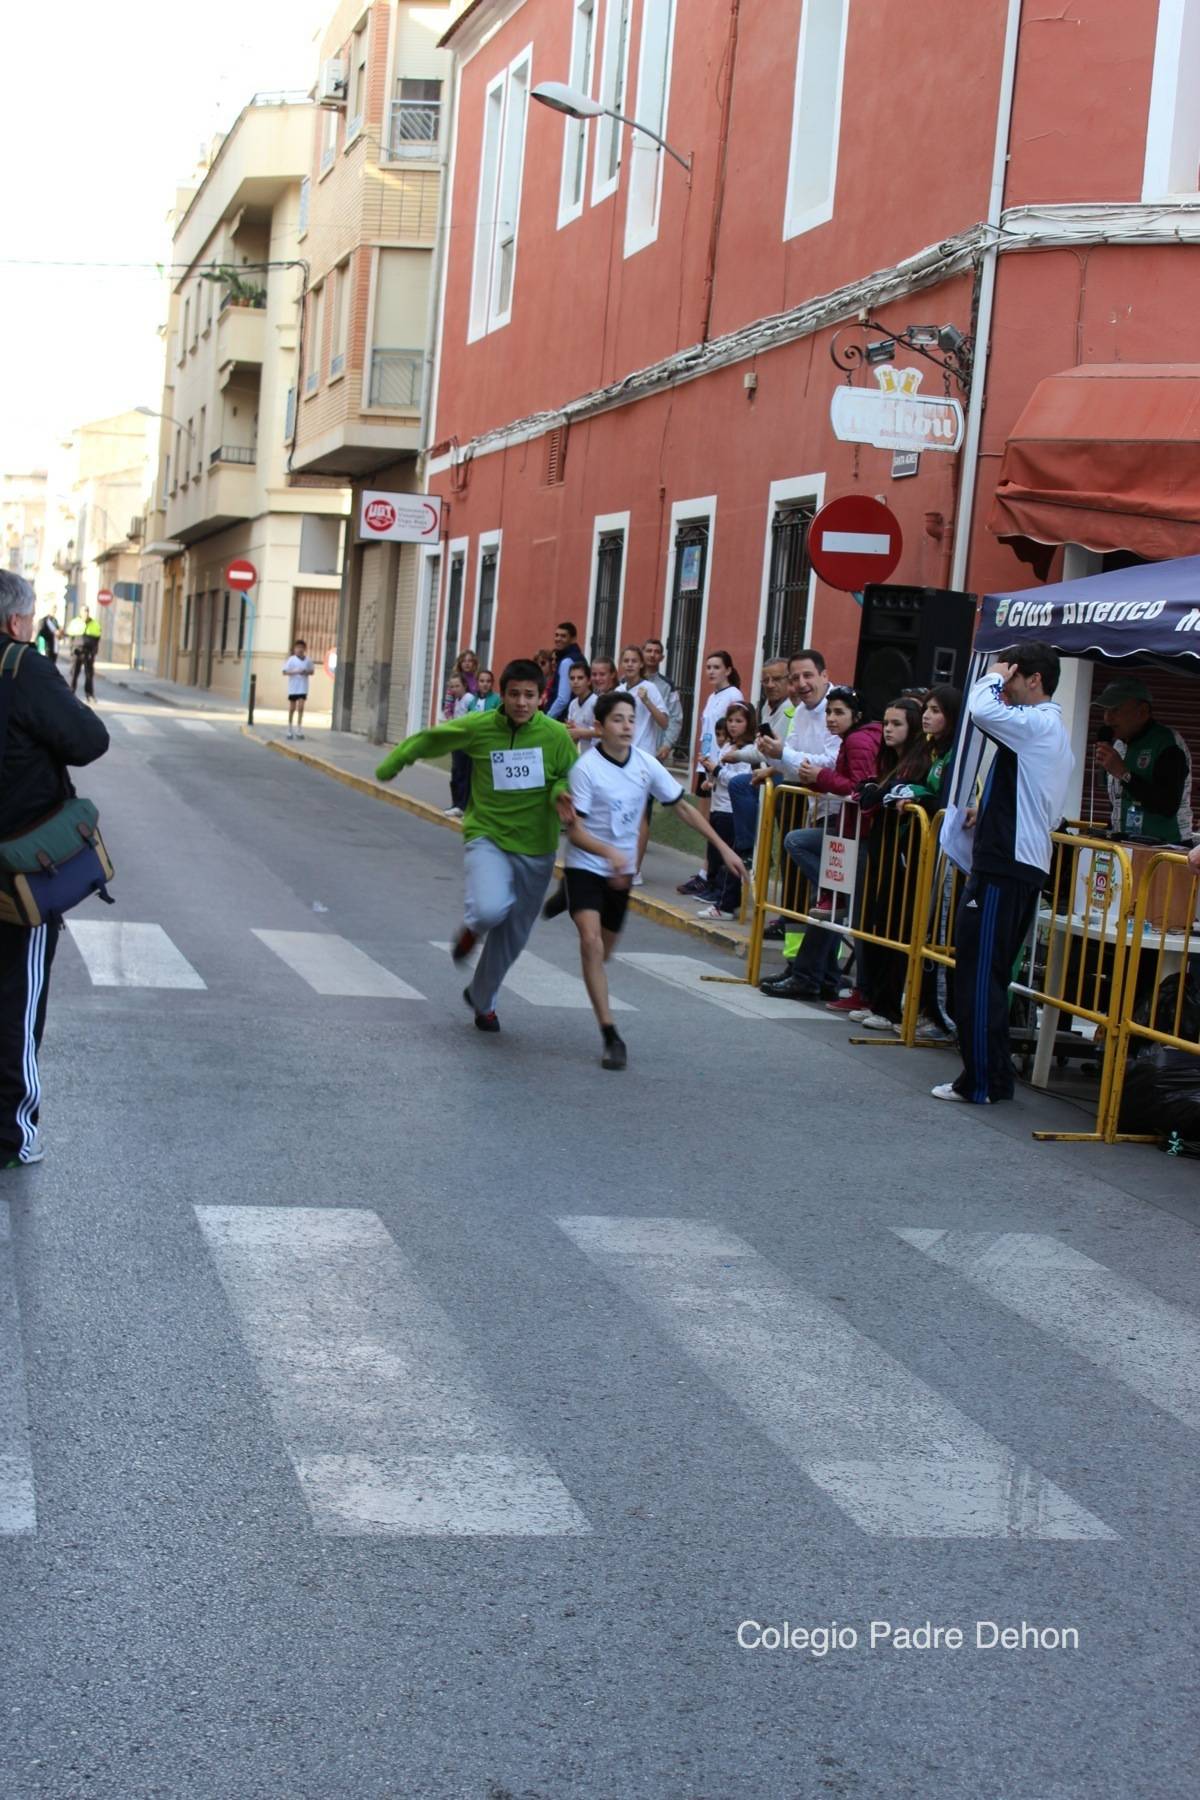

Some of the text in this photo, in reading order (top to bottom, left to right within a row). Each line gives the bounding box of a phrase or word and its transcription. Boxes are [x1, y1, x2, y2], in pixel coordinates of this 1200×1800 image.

[369, 504, 393, 517] UGT
[1008, 602, 1054, 627] Club
[505, 765, 530, 778] 339
[829, 855, 843, 868] LOCAL
